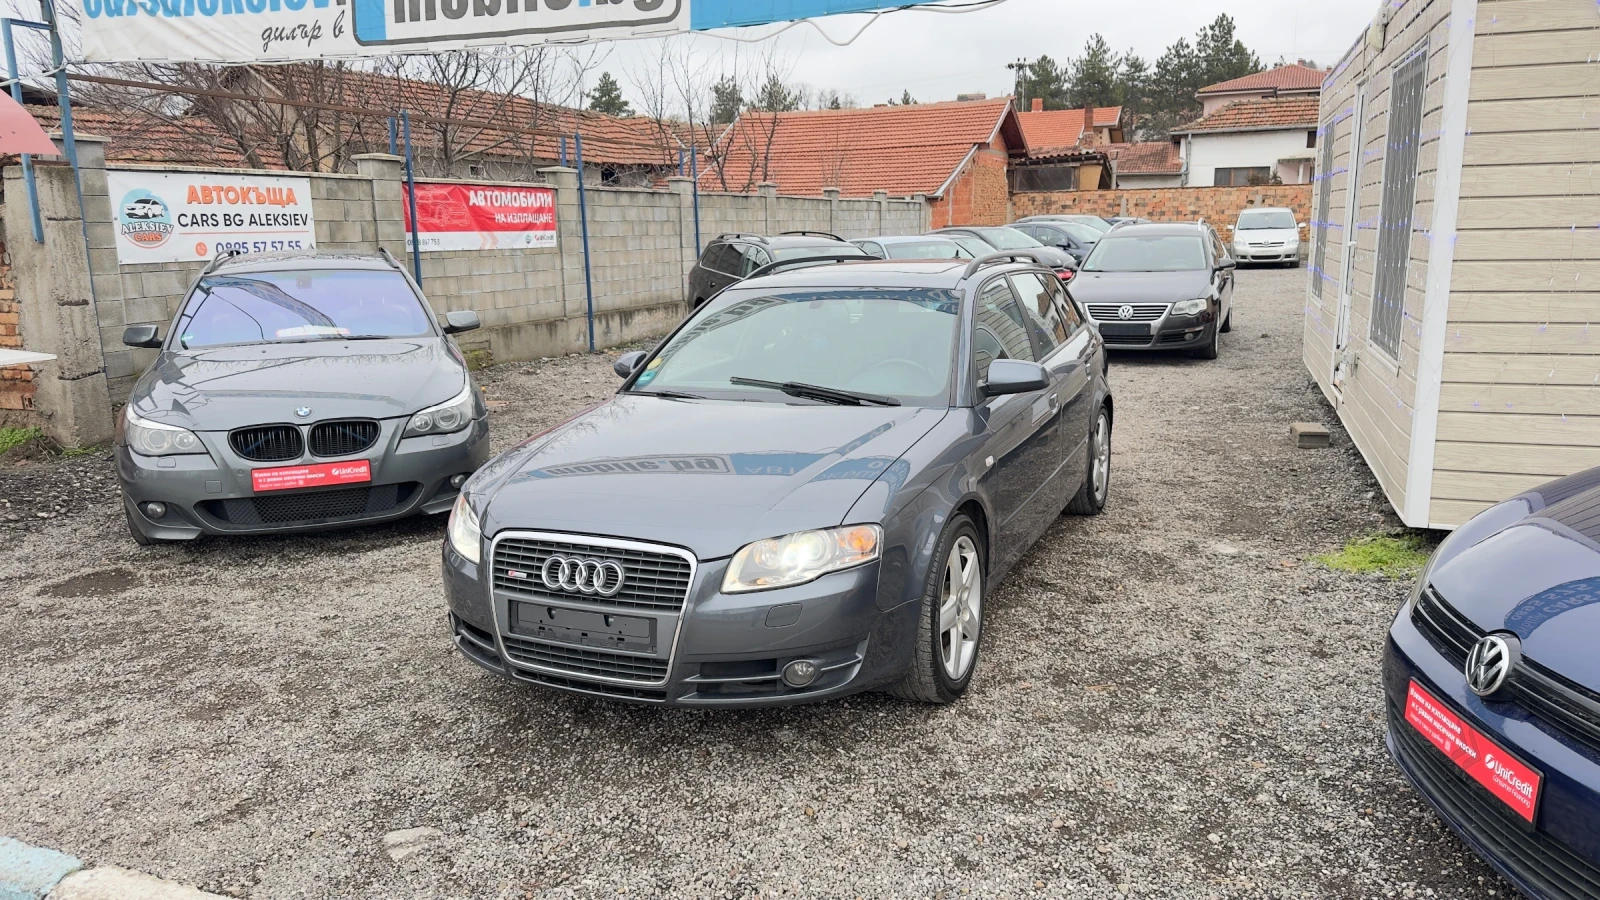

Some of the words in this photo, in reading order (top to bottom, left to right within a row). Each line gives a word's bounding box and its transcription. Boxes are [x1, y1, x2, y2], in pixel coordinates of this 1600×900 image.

[261, 19, 323, 52] дилър
[186, 184, 298, 208] АВТОКЪЩА
[469, 190, 553, 208] АВТОМОБИЛИ
[177, 213, 220, 227] CARS
[223, 213, 244, 227] BG
[248, 213, 308, 227] ALEKSIEV
[494, 213, 506, 223] НА
[507, 213, 553, 225] ИЗПЛАЩАНЕ
[121, 220, 174, 235] ALEKSIEV
[133, 232, 163, 242] CARS
[253, 241, 267, 253] 57
[1494, 760, 1533, 799] UniCredit
